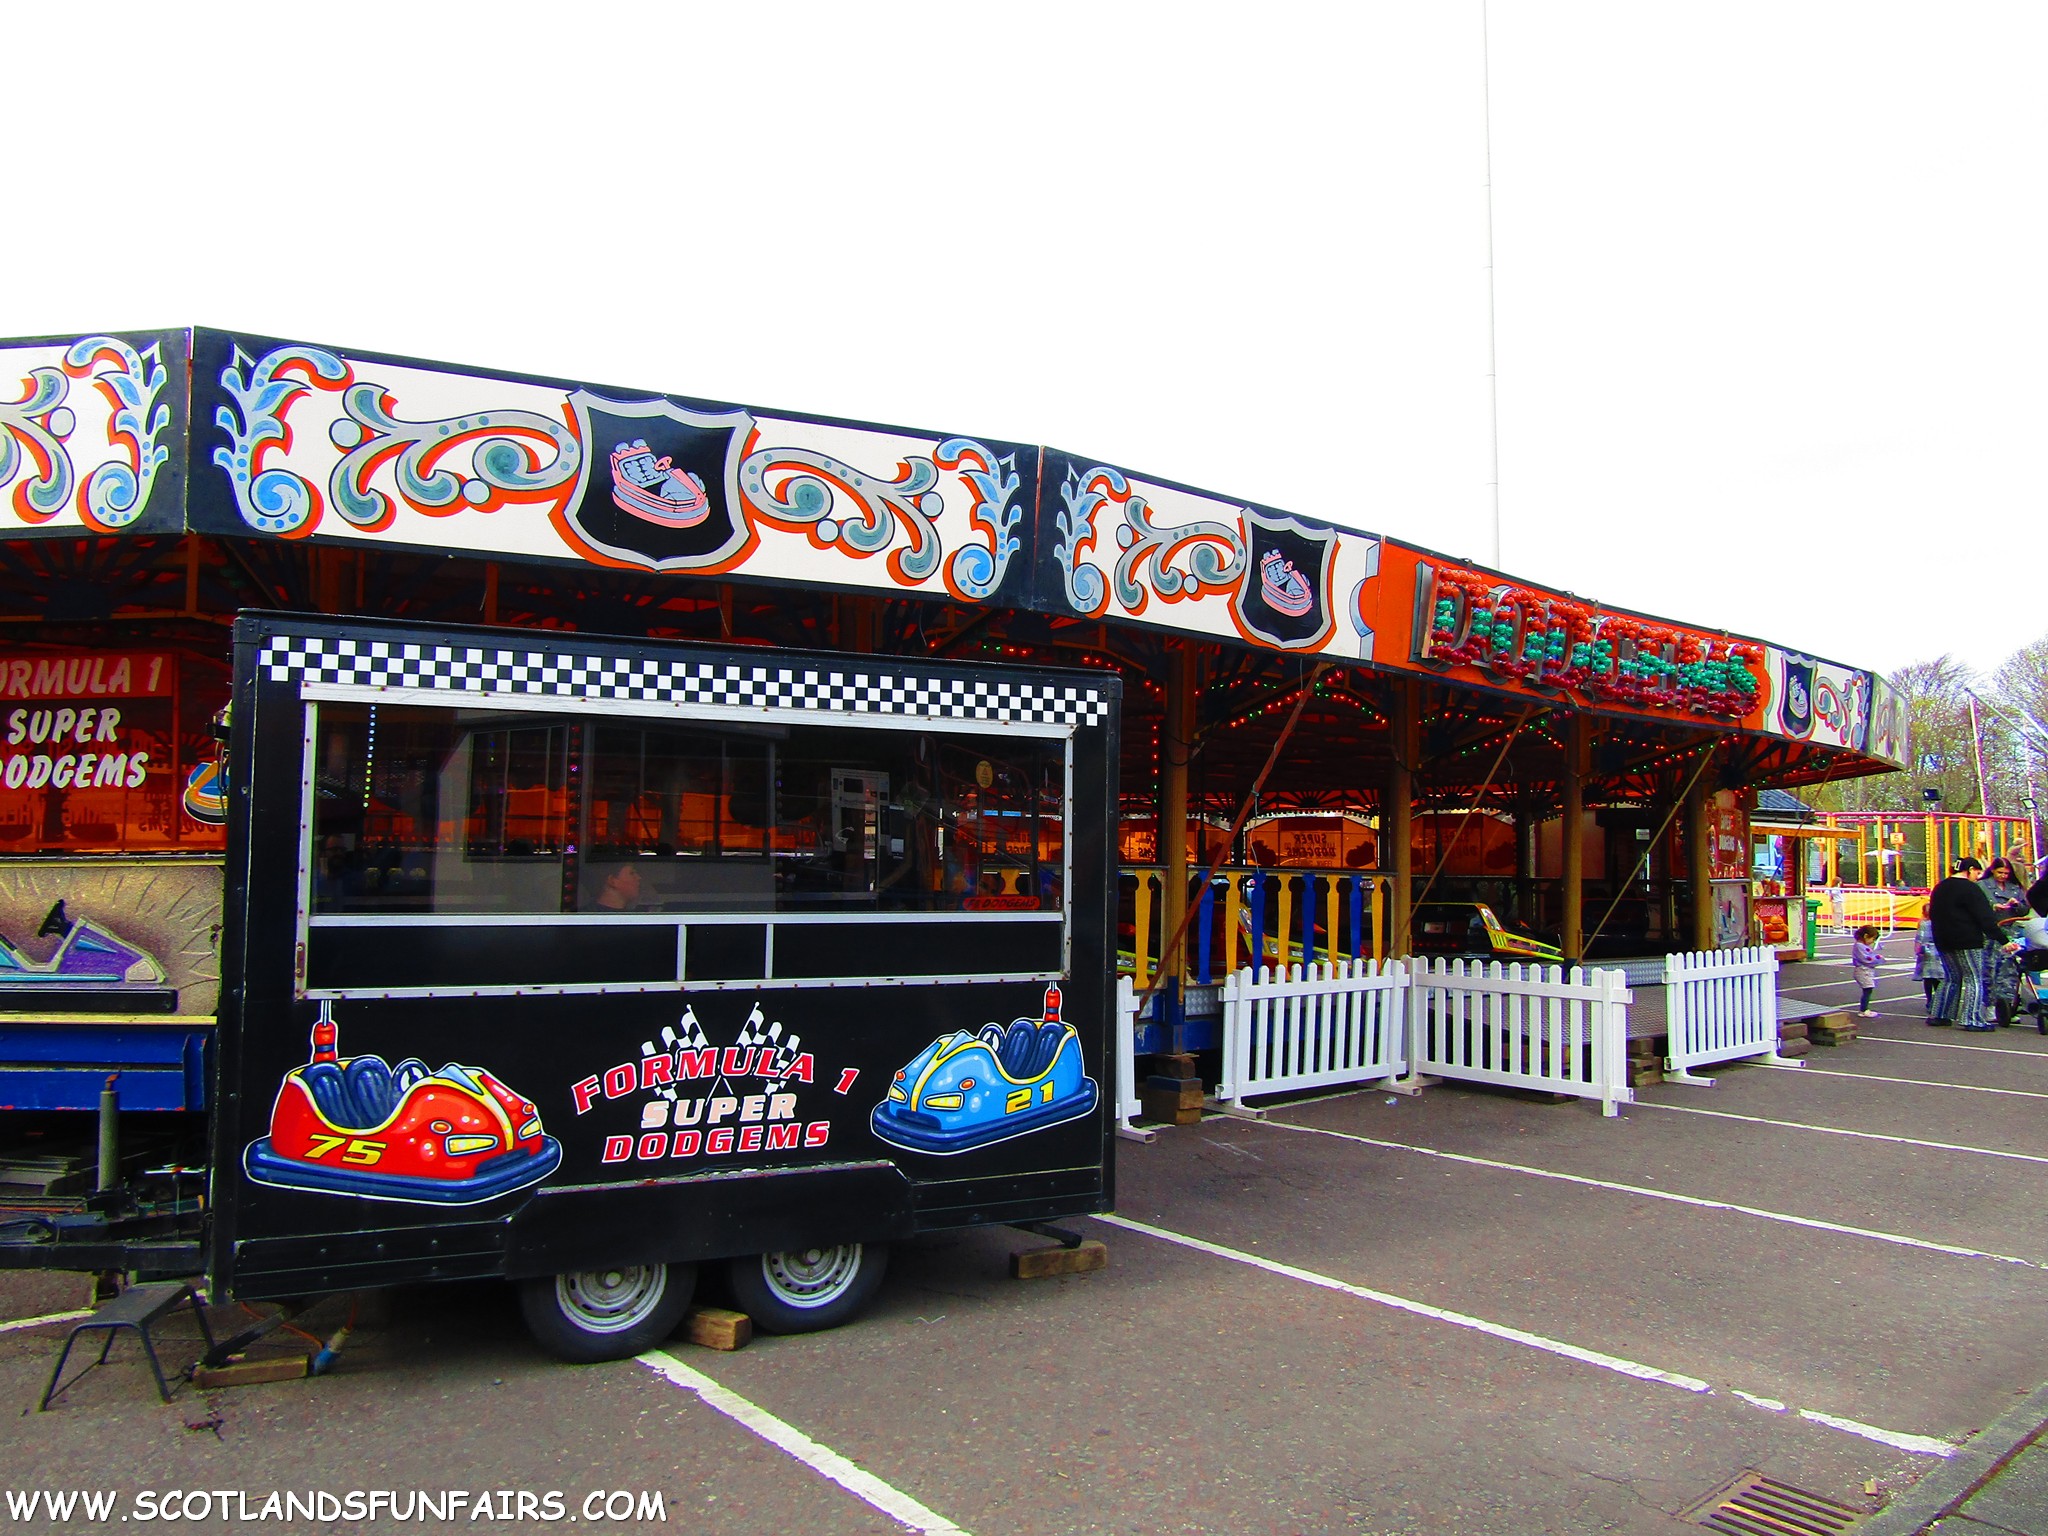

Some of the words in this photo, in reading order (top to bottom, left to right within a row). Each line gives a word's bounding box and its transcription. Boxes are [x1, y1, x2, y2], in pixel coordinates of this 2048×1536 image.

[1412, 562, 1765, 720] DODGEMS
[149, 656, 163, 692] 1
[7, 707, 122, 745] SUPER
[0, 751, 149, 789] ODGEMS
[982, 898, 1037, 908] DODGEMS
[571, 1046, 814, 1115] FORMULA
[834, 1068, 860, 1095] 1
[1005, 1080, 1054, 1115] 21
[640, 1093, 797, 1128] SUPER
[304, 1134, 387, 1165] 75
[601, 1121, 830, 1163] DODGEMS
